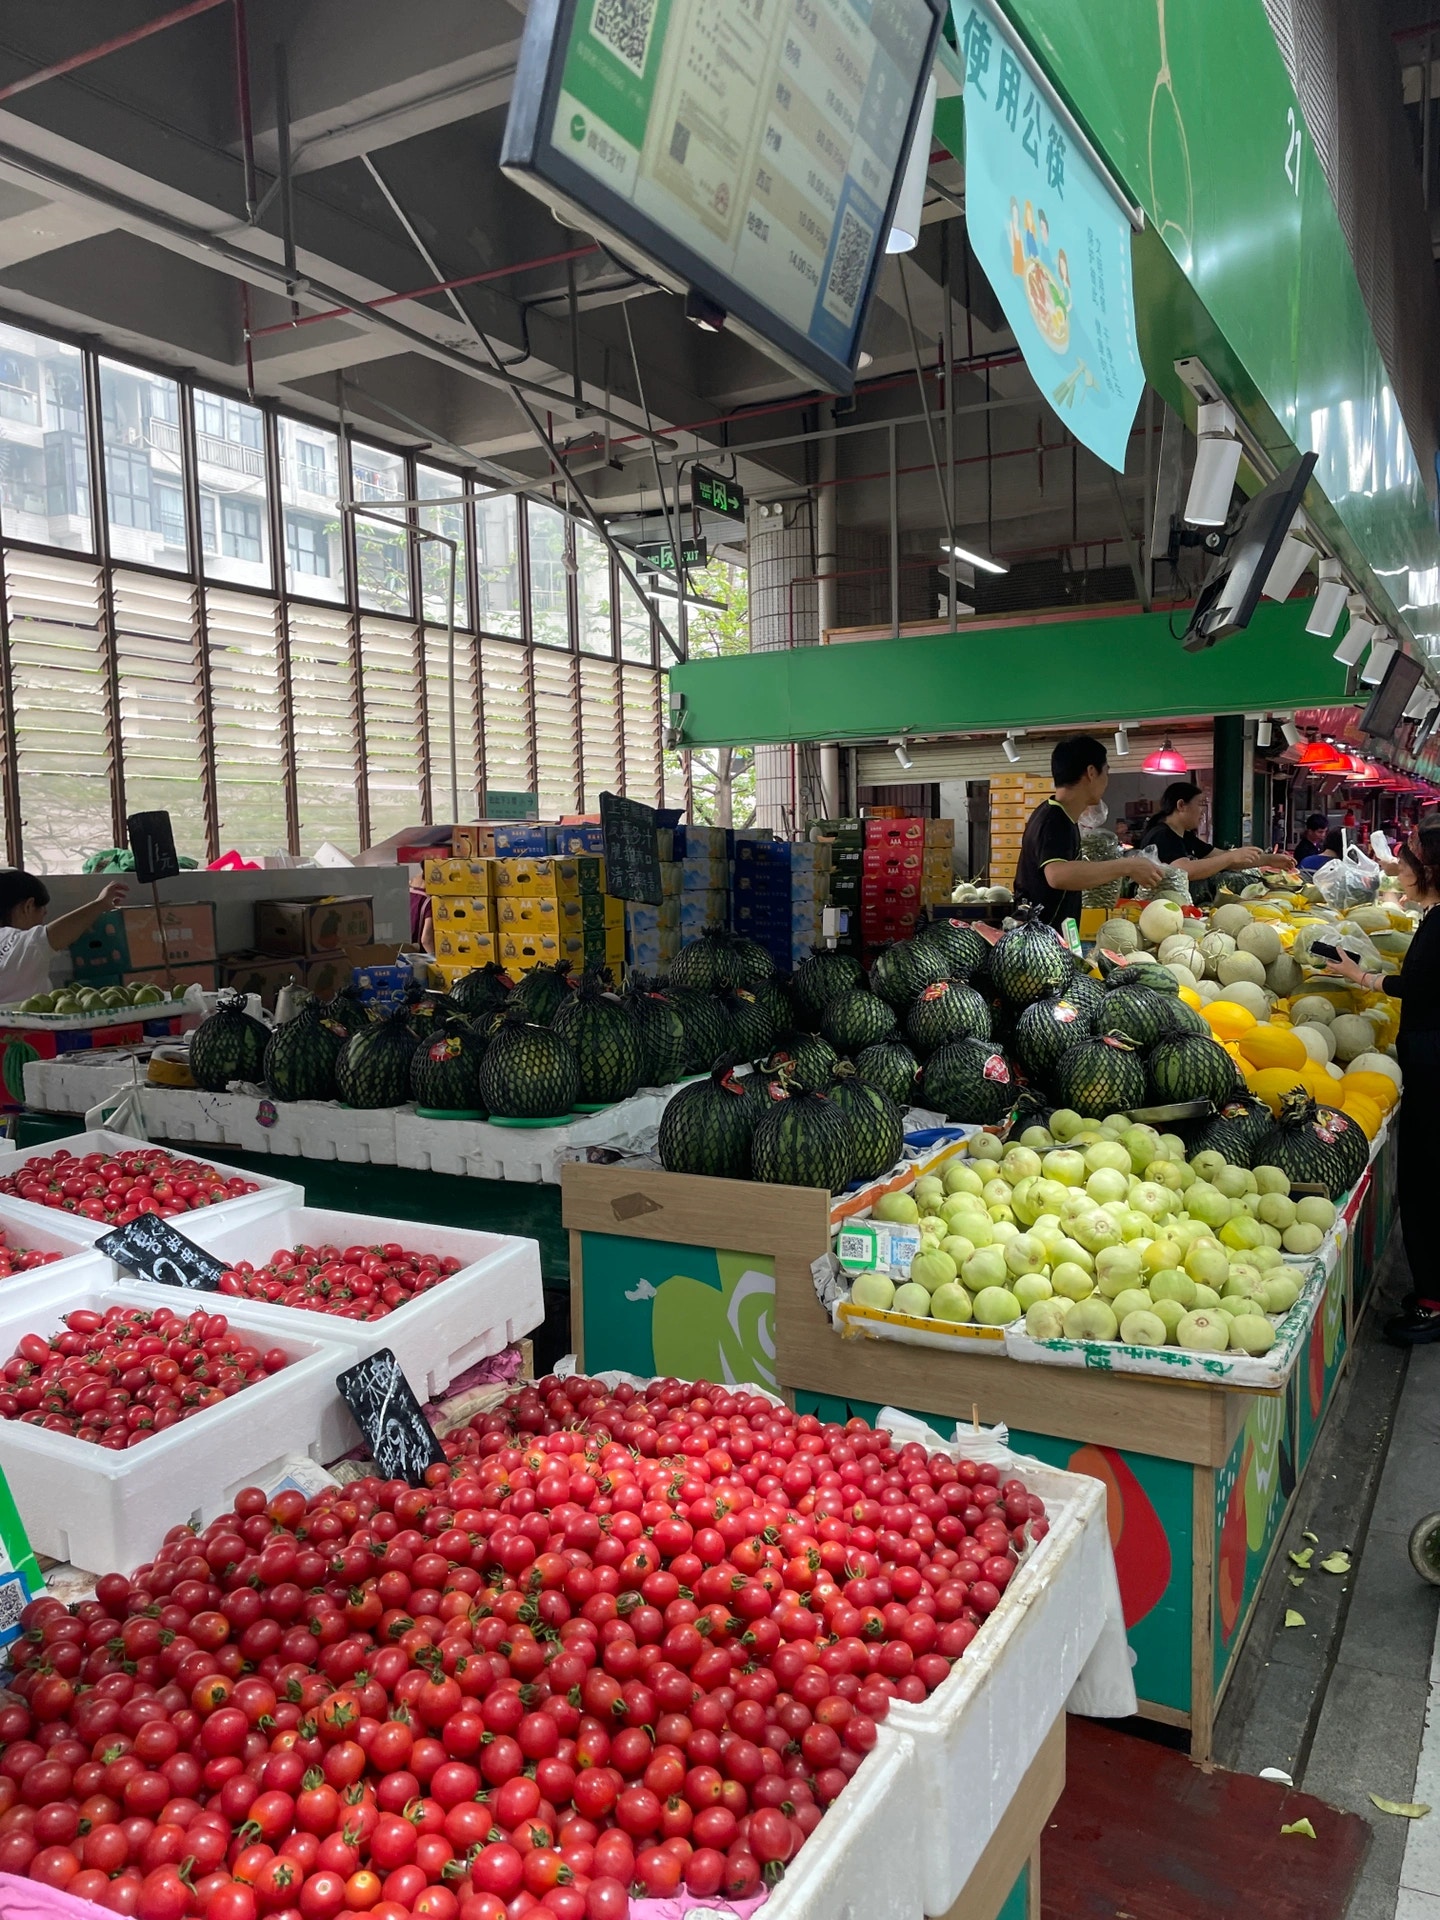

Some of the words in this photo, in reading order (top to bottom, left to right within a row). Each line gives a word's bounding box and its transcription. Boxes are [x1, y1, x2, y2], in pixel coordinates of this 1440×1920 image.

[962, 9, 1066, 201] 使用公筷
[587, 129, 627, 174] 微信支付
[756, 167, 773, 195] 西瓜
[747, 210, 770, 244] 哈密瓜
[517, 864, 528, 872] AA
[520, 901, 532, 909] AA
[458, 935, 469, 943] AA
[522, 937, 534, 945] AA
